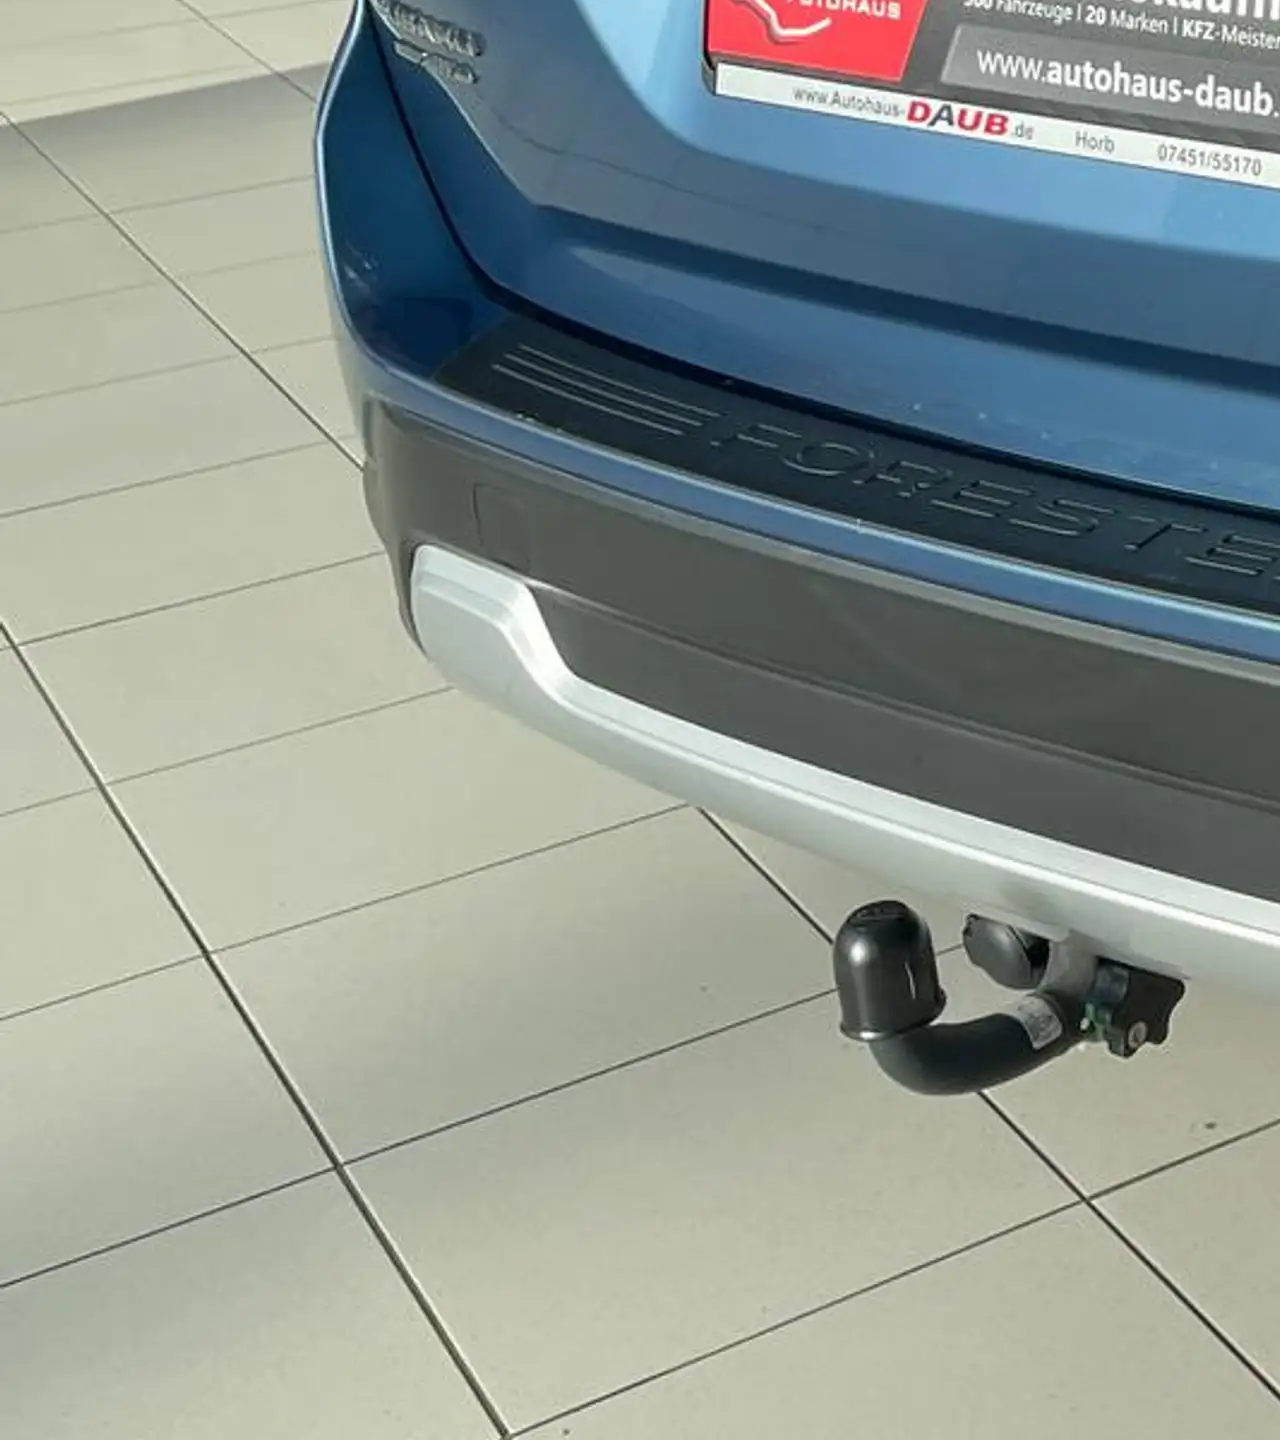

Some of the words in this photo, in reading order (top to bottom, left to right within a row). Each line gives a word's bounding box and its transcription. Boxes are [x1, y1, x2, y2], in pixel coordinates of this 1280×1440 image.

[1084, 4, 1106, 26] 20
[1110, 10, 1169, 35] Marken
[1075, 130, 1115, 154] Horb
[1157, 143, 1263, 177] 07451/55170
